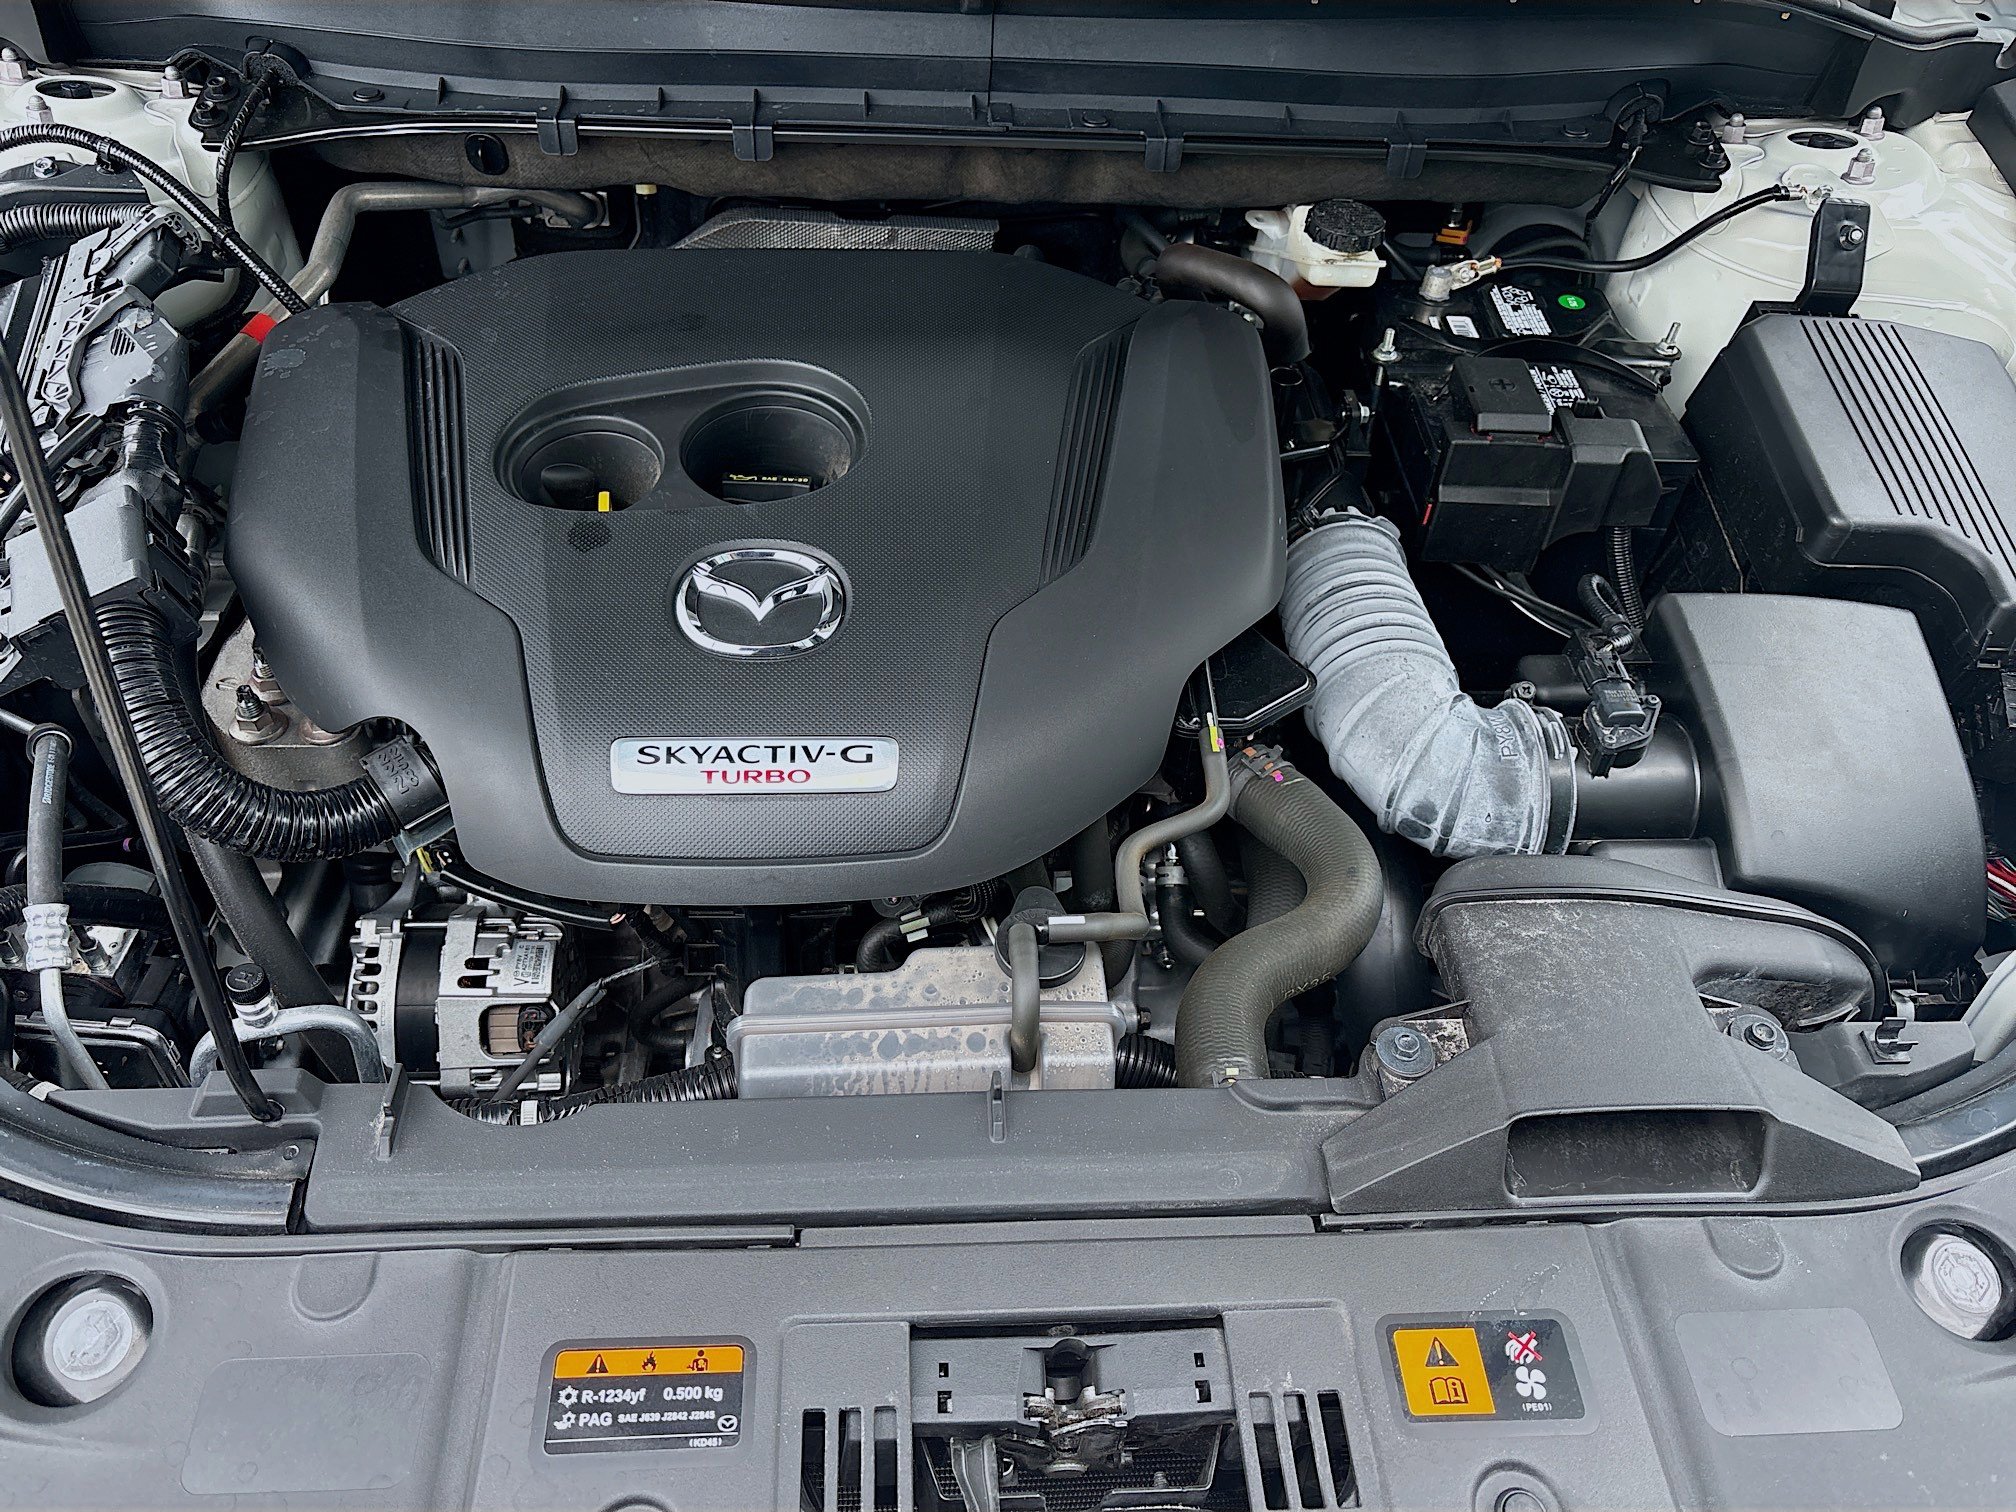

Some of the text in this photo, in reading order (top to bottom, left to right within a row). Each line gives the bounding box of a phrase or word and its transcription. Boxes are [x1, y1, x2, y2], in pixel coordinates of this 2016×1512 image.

[636, 744, 874, 765] SKYACTIV-G
[700, 769, 811, 784] TURBO
[581, 1385, 723, 1405] R-1234yf 0.500 kg
[1522, 1402, 1553, 1412] (PE01)
[578, 1412, 613, 1427] PAG
[617, 1413, 638, 1423] SAE
